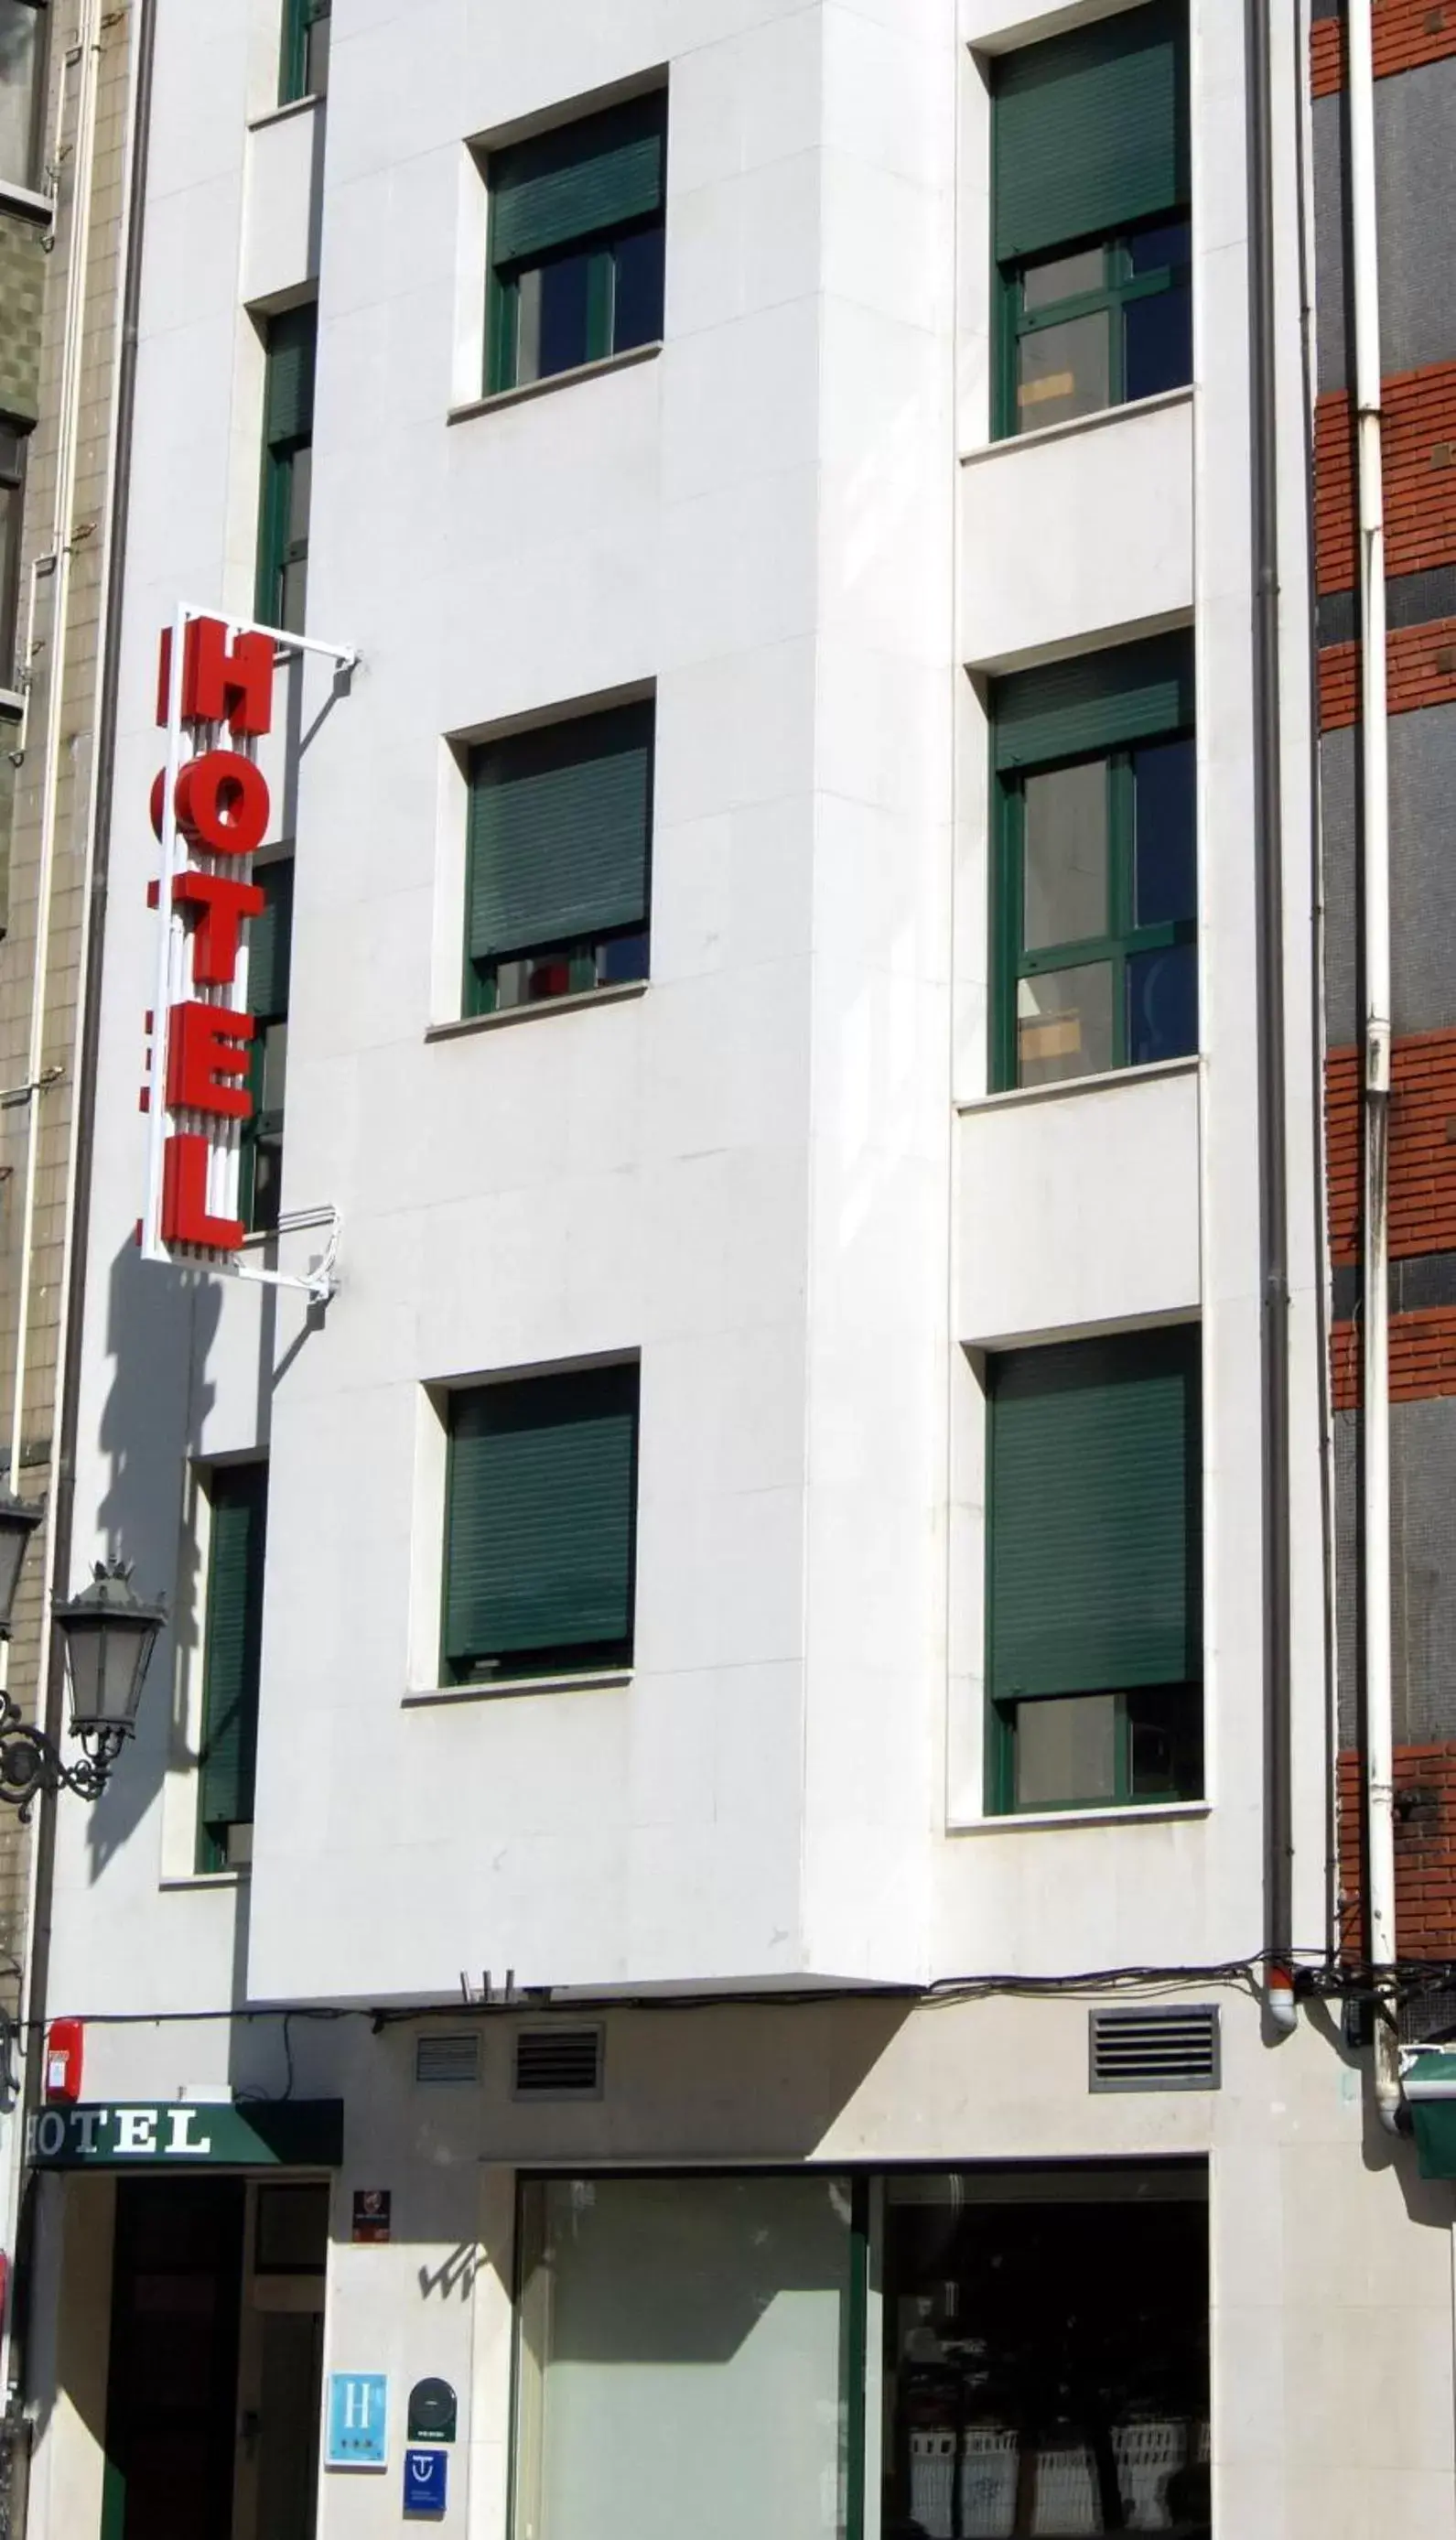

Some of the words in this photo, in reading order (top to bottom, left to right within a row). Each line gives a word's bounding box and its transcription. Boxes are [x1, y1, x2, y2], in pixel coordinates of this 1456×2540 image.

[160, 615, 275, 1251] HOTEL
[26, 2108, 211, 2156] HOTEL
[344, 2383, 371, 2428] H
